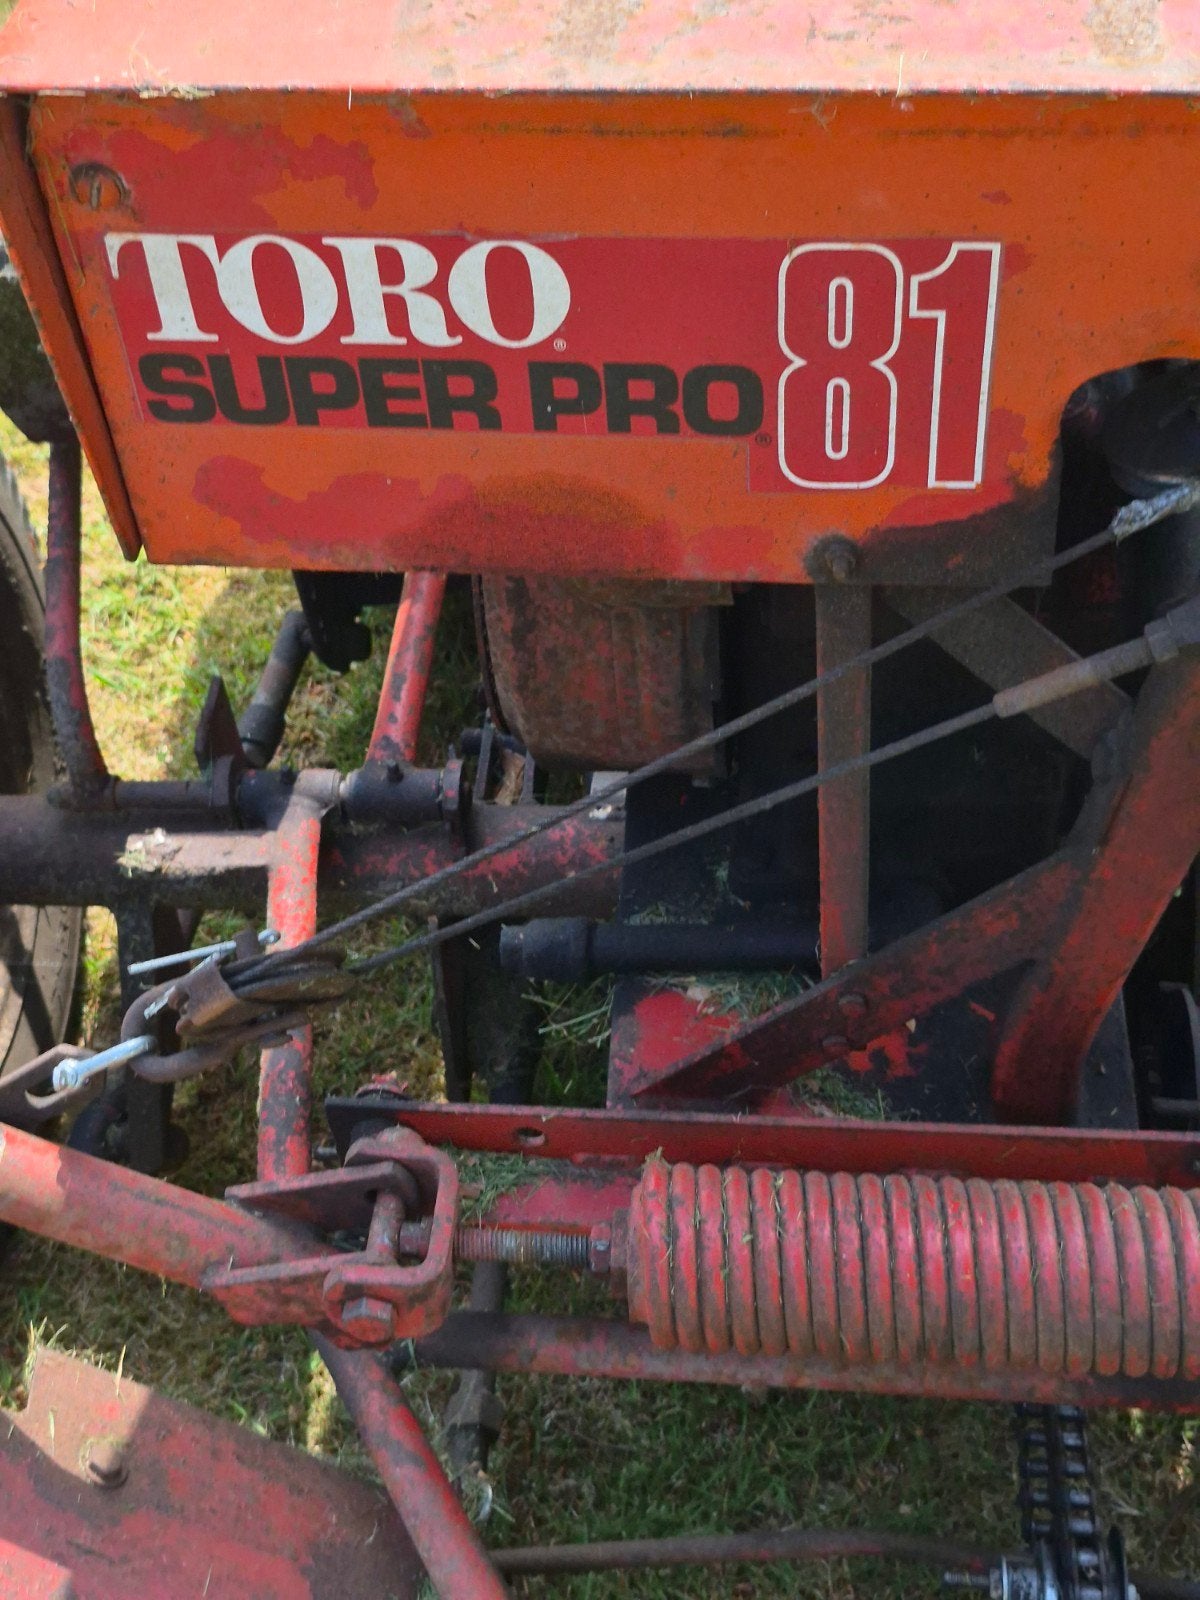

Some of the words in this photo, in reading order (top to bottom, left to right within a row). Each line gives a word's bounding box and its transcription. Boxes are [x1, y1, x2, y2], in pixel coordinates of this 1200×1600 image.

[104, 232, 571, 349] TORO
[138, 353, 503, 431] SUPER
[528, 361, 764, 435] PRO
[778, 241, 1001, 490] 81
